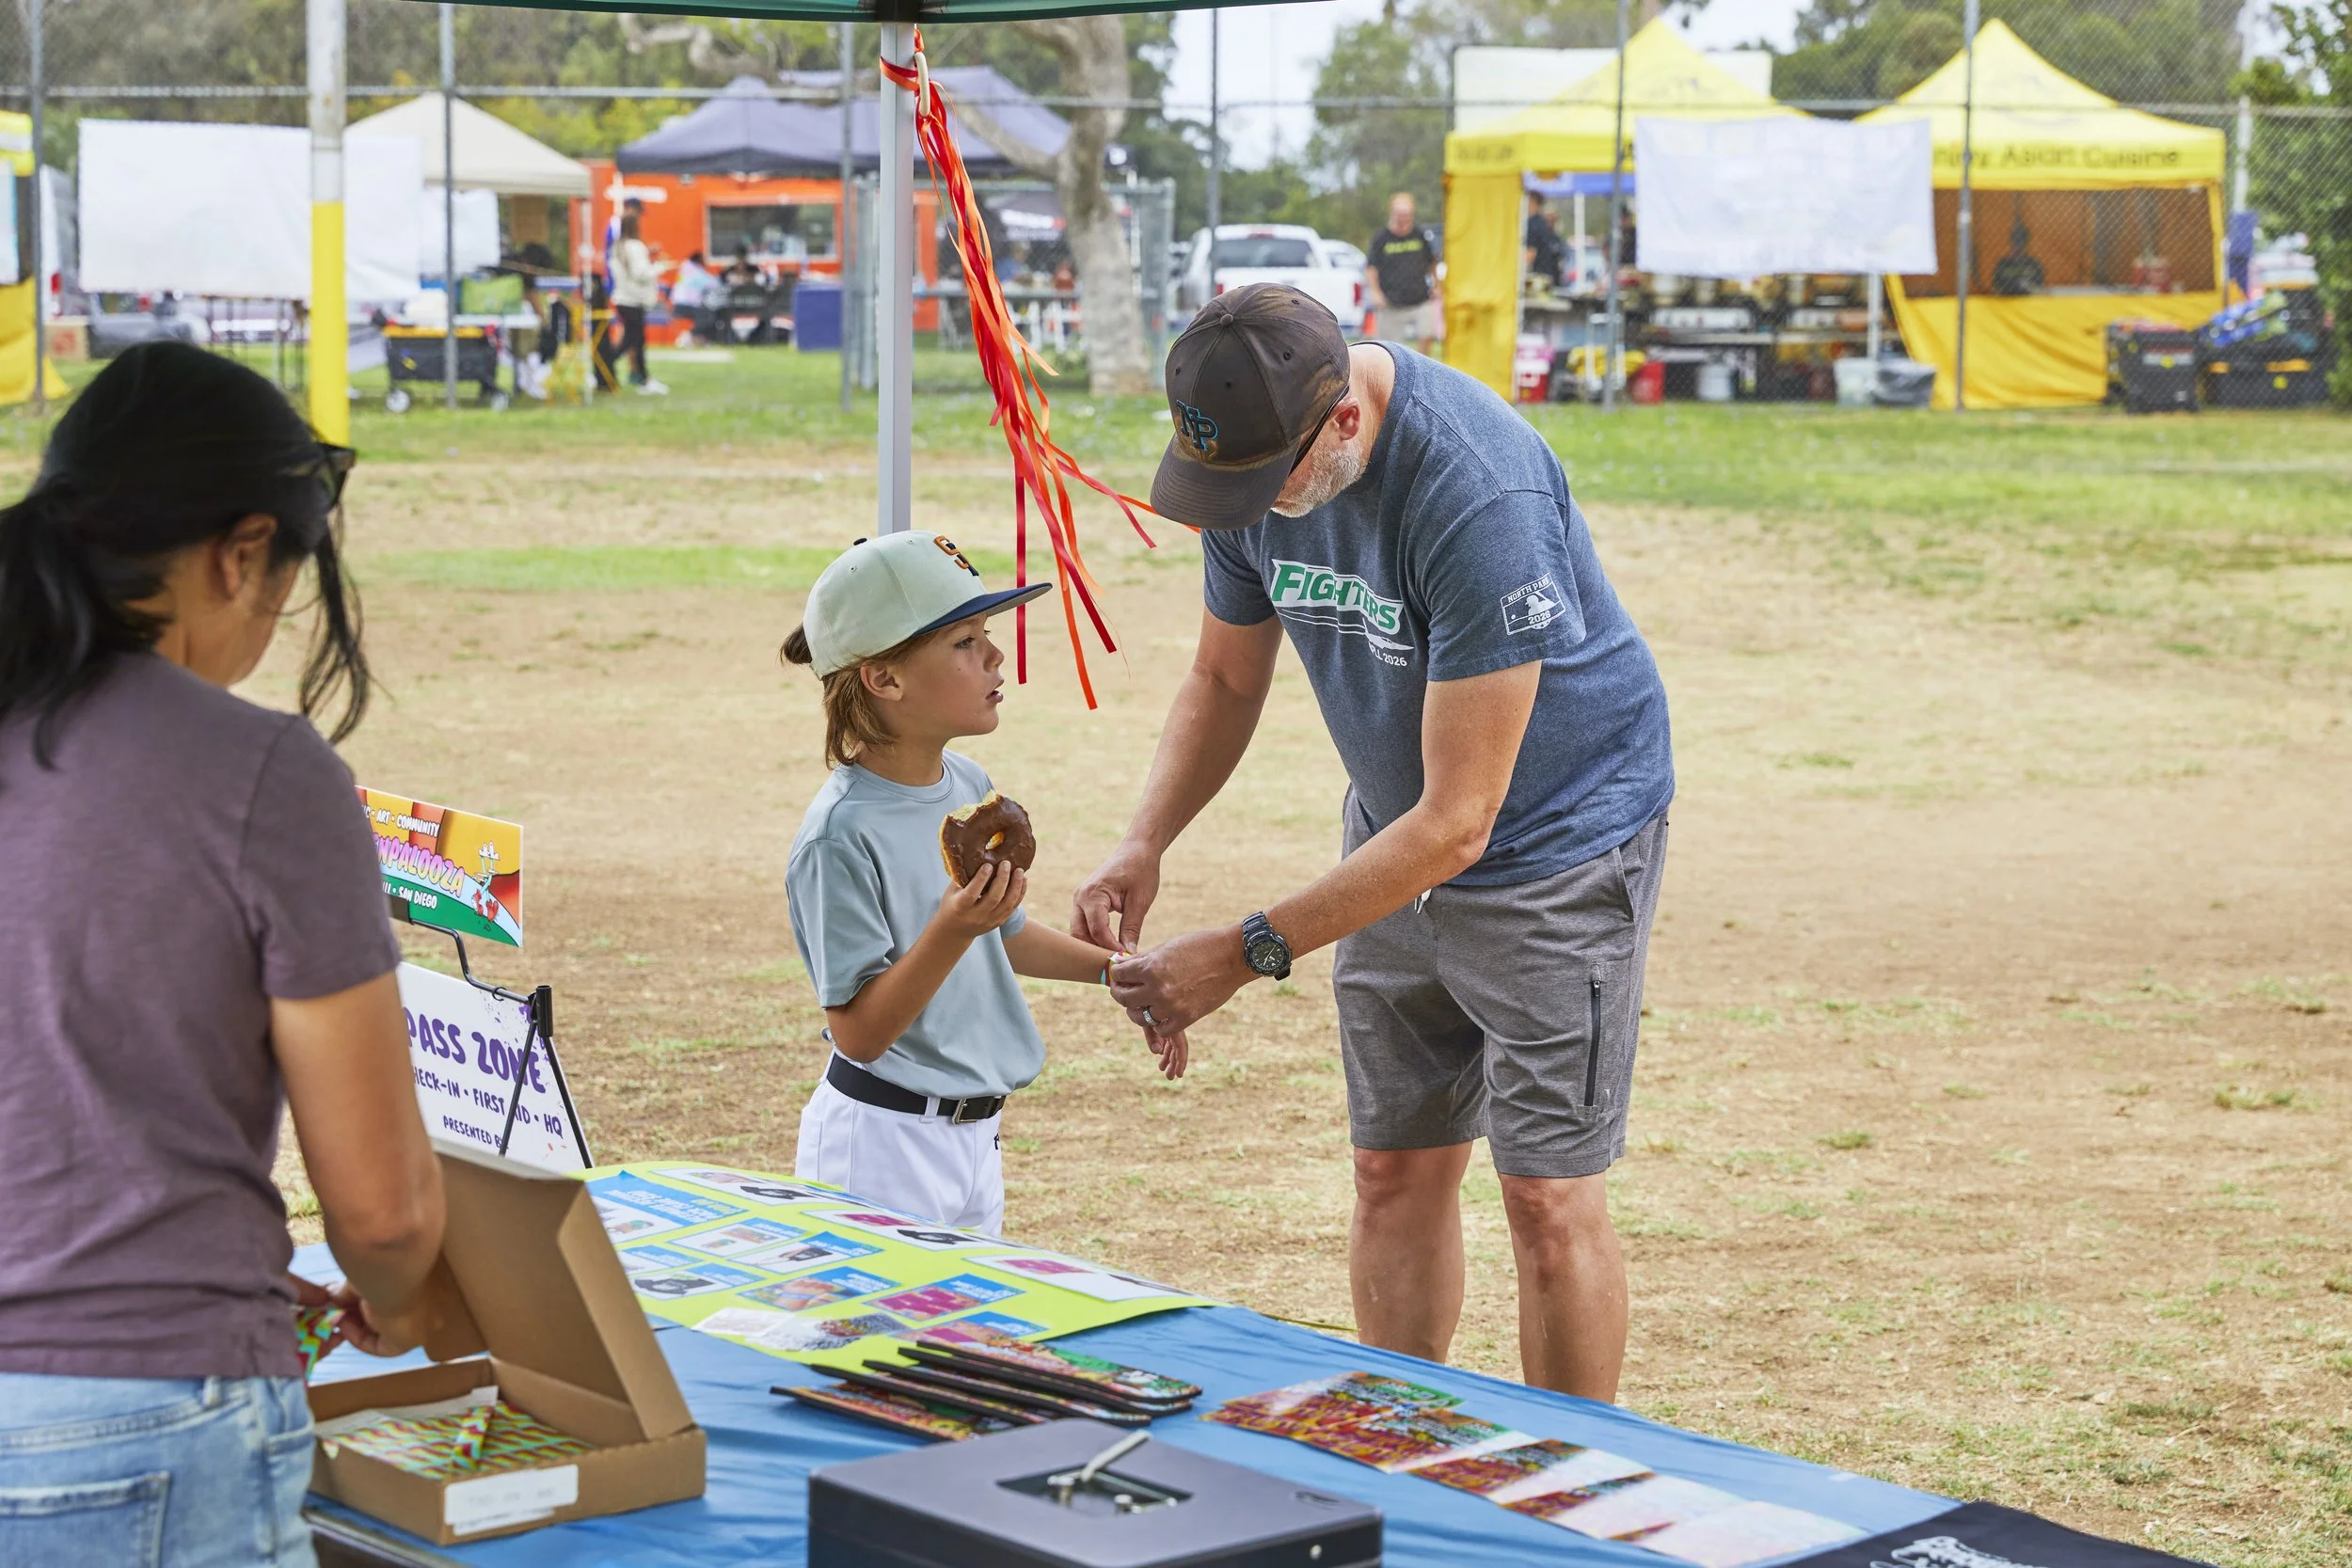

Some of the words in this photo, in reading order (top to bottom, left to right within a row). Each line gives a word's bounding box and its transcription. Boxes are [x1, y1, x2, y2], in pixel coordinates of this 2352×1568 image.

[1177, 400, 1218, 451] NP
[1272, 563, 1397, 630] FIGHTERS
[1507, 585, 1533, 603] NORTH
[1528, 610, 1551, 626] 2026
[1383, 653, 1407, 667] 2026
[376, 809, 391, 825] ART
[396, 814, 440, 838] COMMUNITY
[372, 832, 465, 898] NPALOOZA
[398, 885, 413, 902] SAN
[413, 889, 437, 910] DIEGO
[470, 1031, 547, 1094] ZONE
[472, 1087, 505, 1116] FIRST
[543, 1113, 564, 1140] HQ
[443, 1115, 492, 1145] PRESENTED
